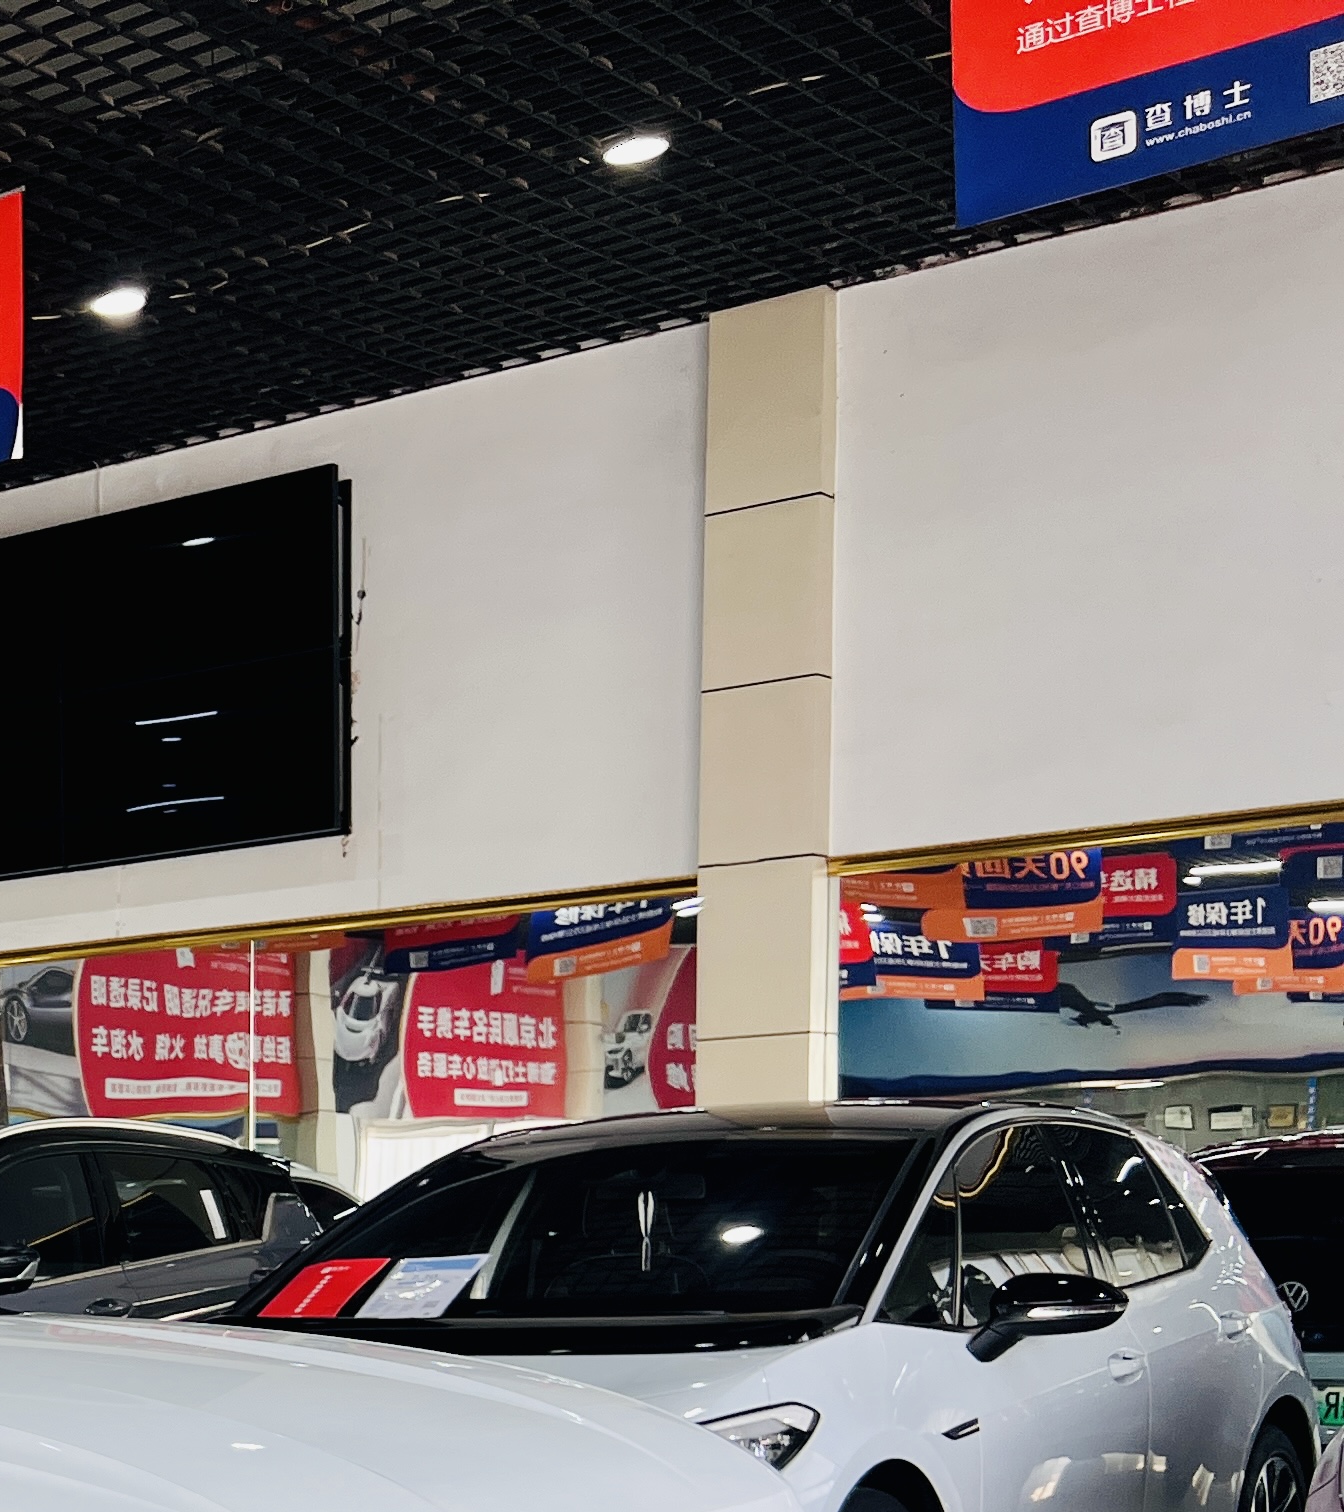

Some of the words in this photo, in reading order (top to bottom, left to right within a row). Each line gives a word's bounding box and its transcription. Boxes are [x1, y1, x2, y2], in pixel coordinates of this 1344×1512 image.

[1145, 80, 1252, 132] 查博士
[1145, 110, 1252, 147] www.chaboshi.cn
